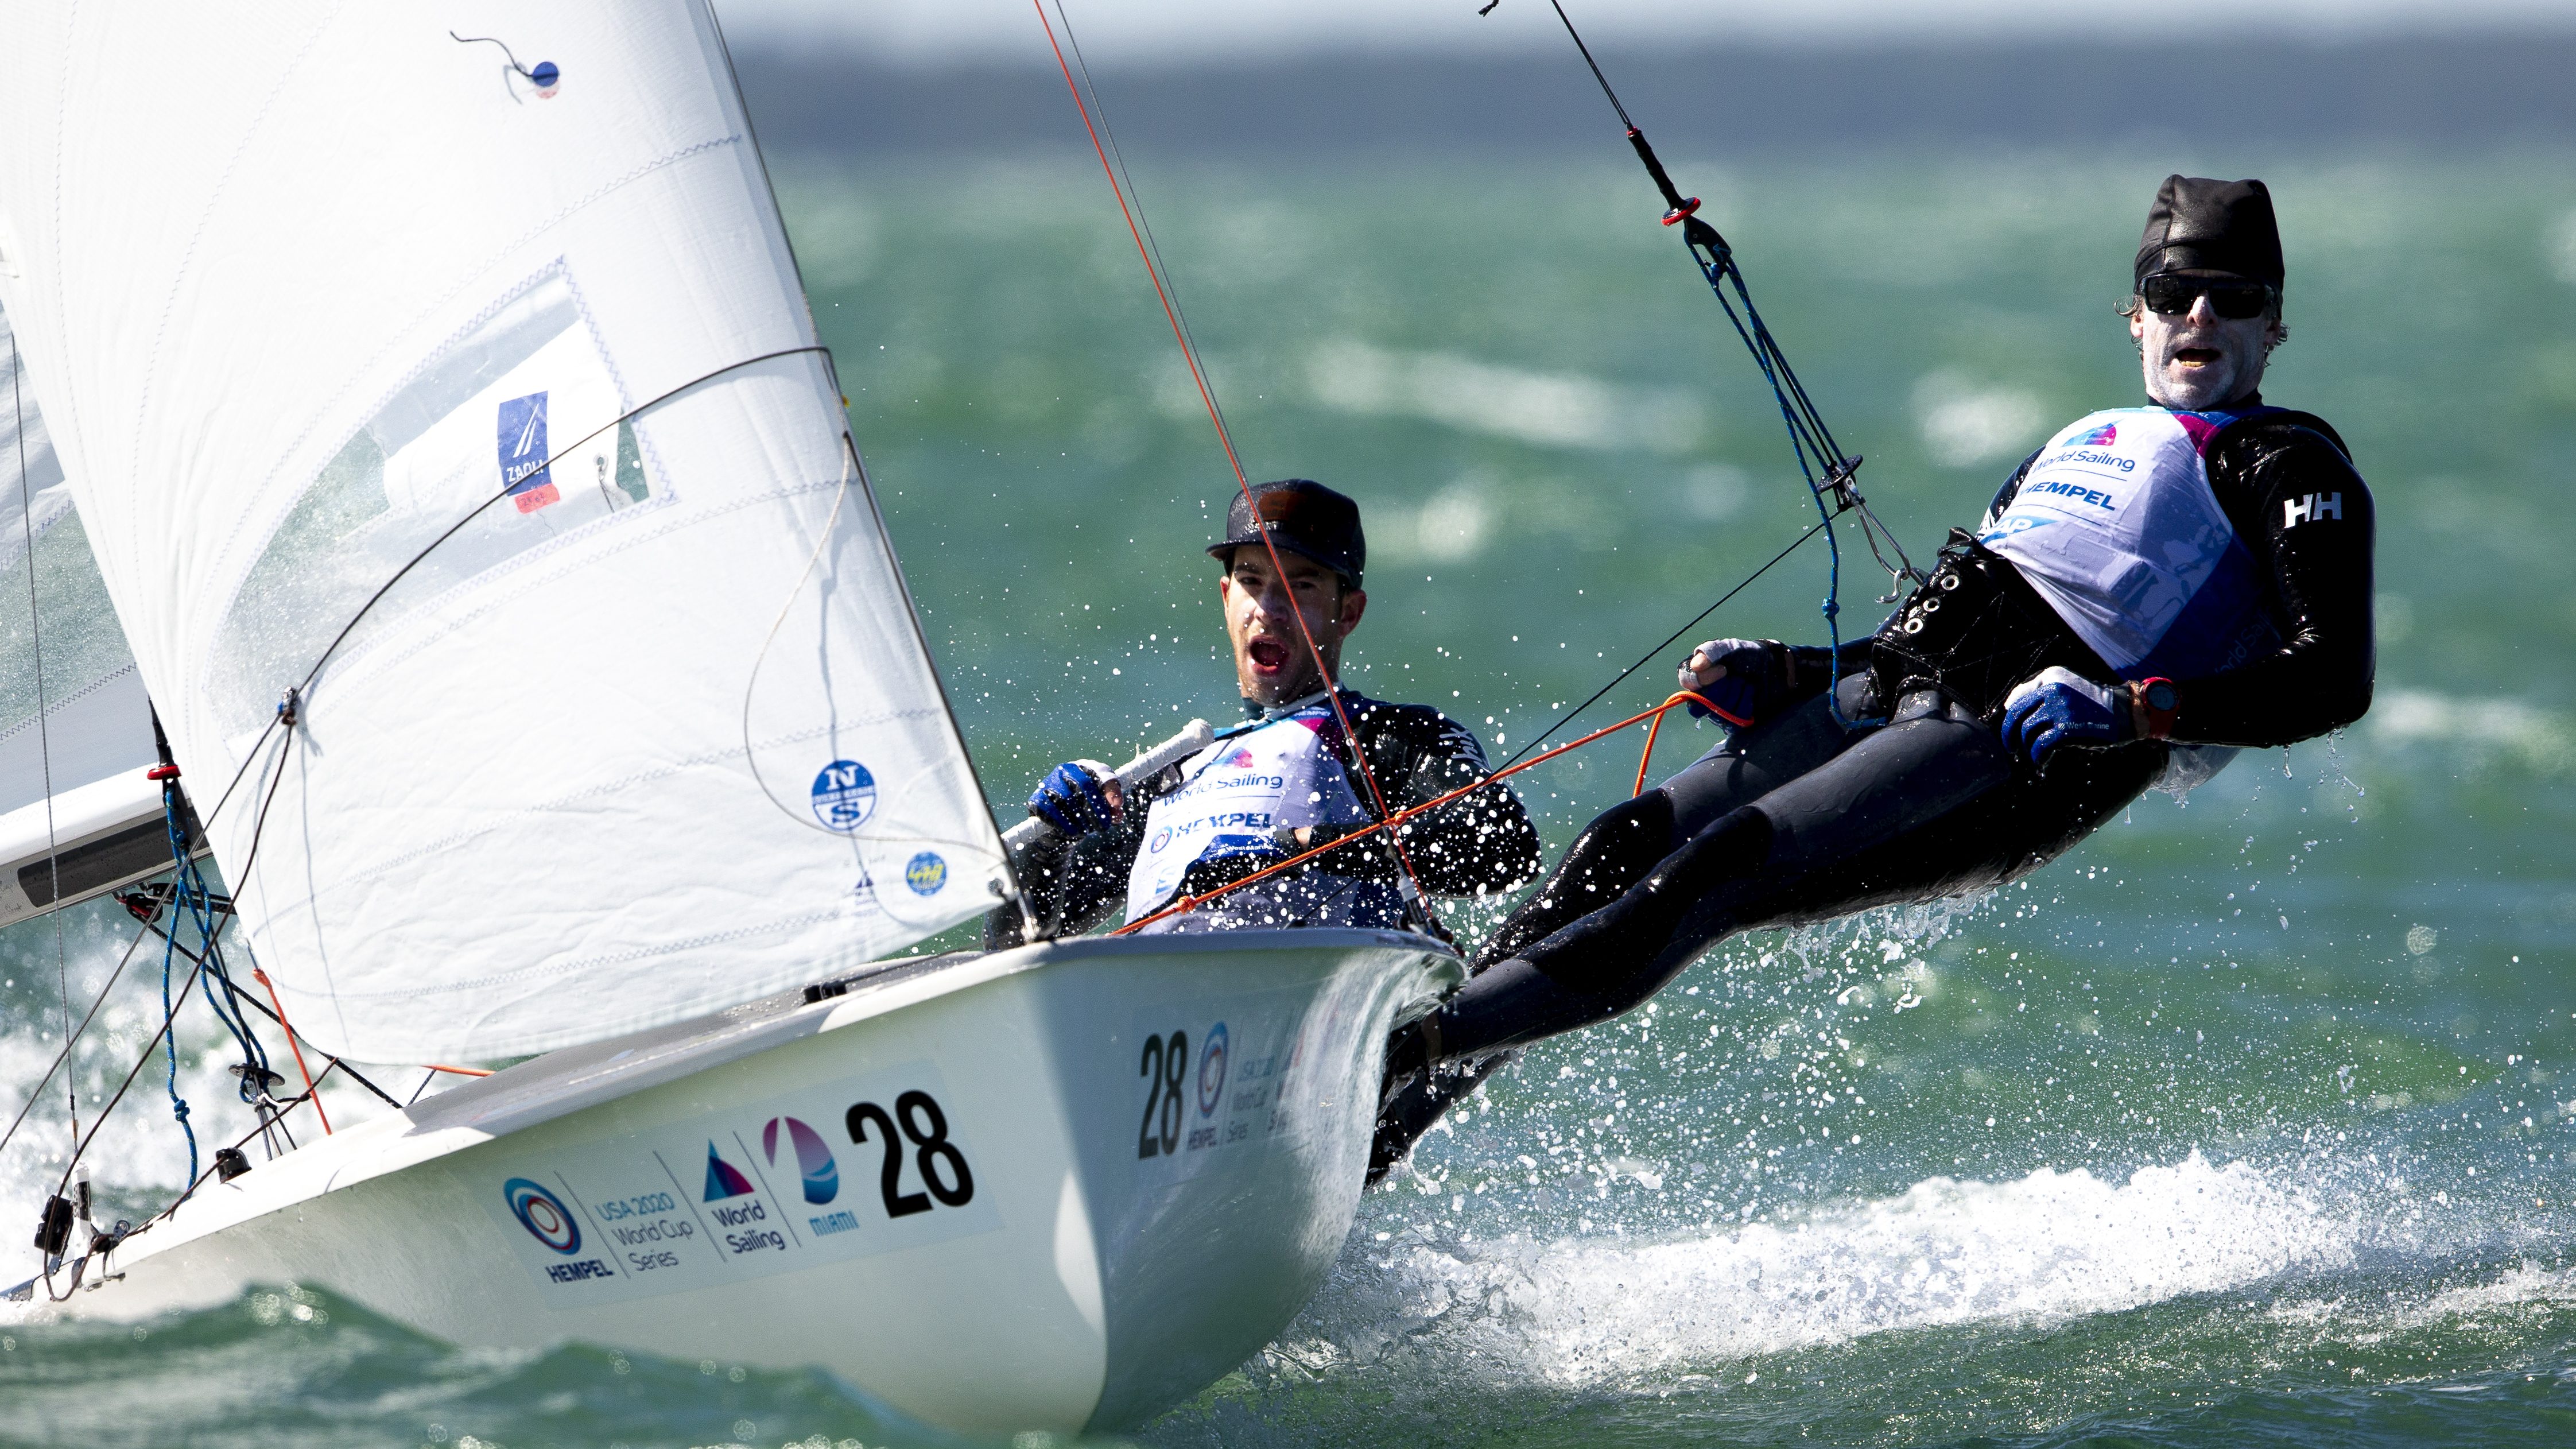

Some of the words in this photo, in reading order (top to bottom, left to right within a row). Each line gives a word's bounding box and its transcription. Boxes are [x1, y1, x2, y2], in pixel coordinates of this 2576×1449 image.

[2073, 451, 2136, 472] Sailing
[2019, 482, 2116, 512] HEMPEL
[2284, 492, 2342, 529] HH
[1989, 518, 2033, 534] AP
[824, 765, 859, 791] N
[1163, 780, 1213, 807] World
[1216, 773, 1283, 789] Sailing
[831, 801, 860, 823] S
[1138, 1029, 1188, 1161] 28
[845, 1089, 974, 1219] 28
[596, 1199, 637, 1221] USA
[631, 1191, 675, 1216] 2020
[712, 1199, 766, 1228] World
[611, 1222, 662, 1246] World
[658, 1219, 694, 1239] Cup
[808, 1210, 859, 1237] MIAMI
[726, 1229, 786, 1254] Sailing
[545, 1258, 614, 1284] HEMPEL
[628, 1249, 680, 1272] Series
